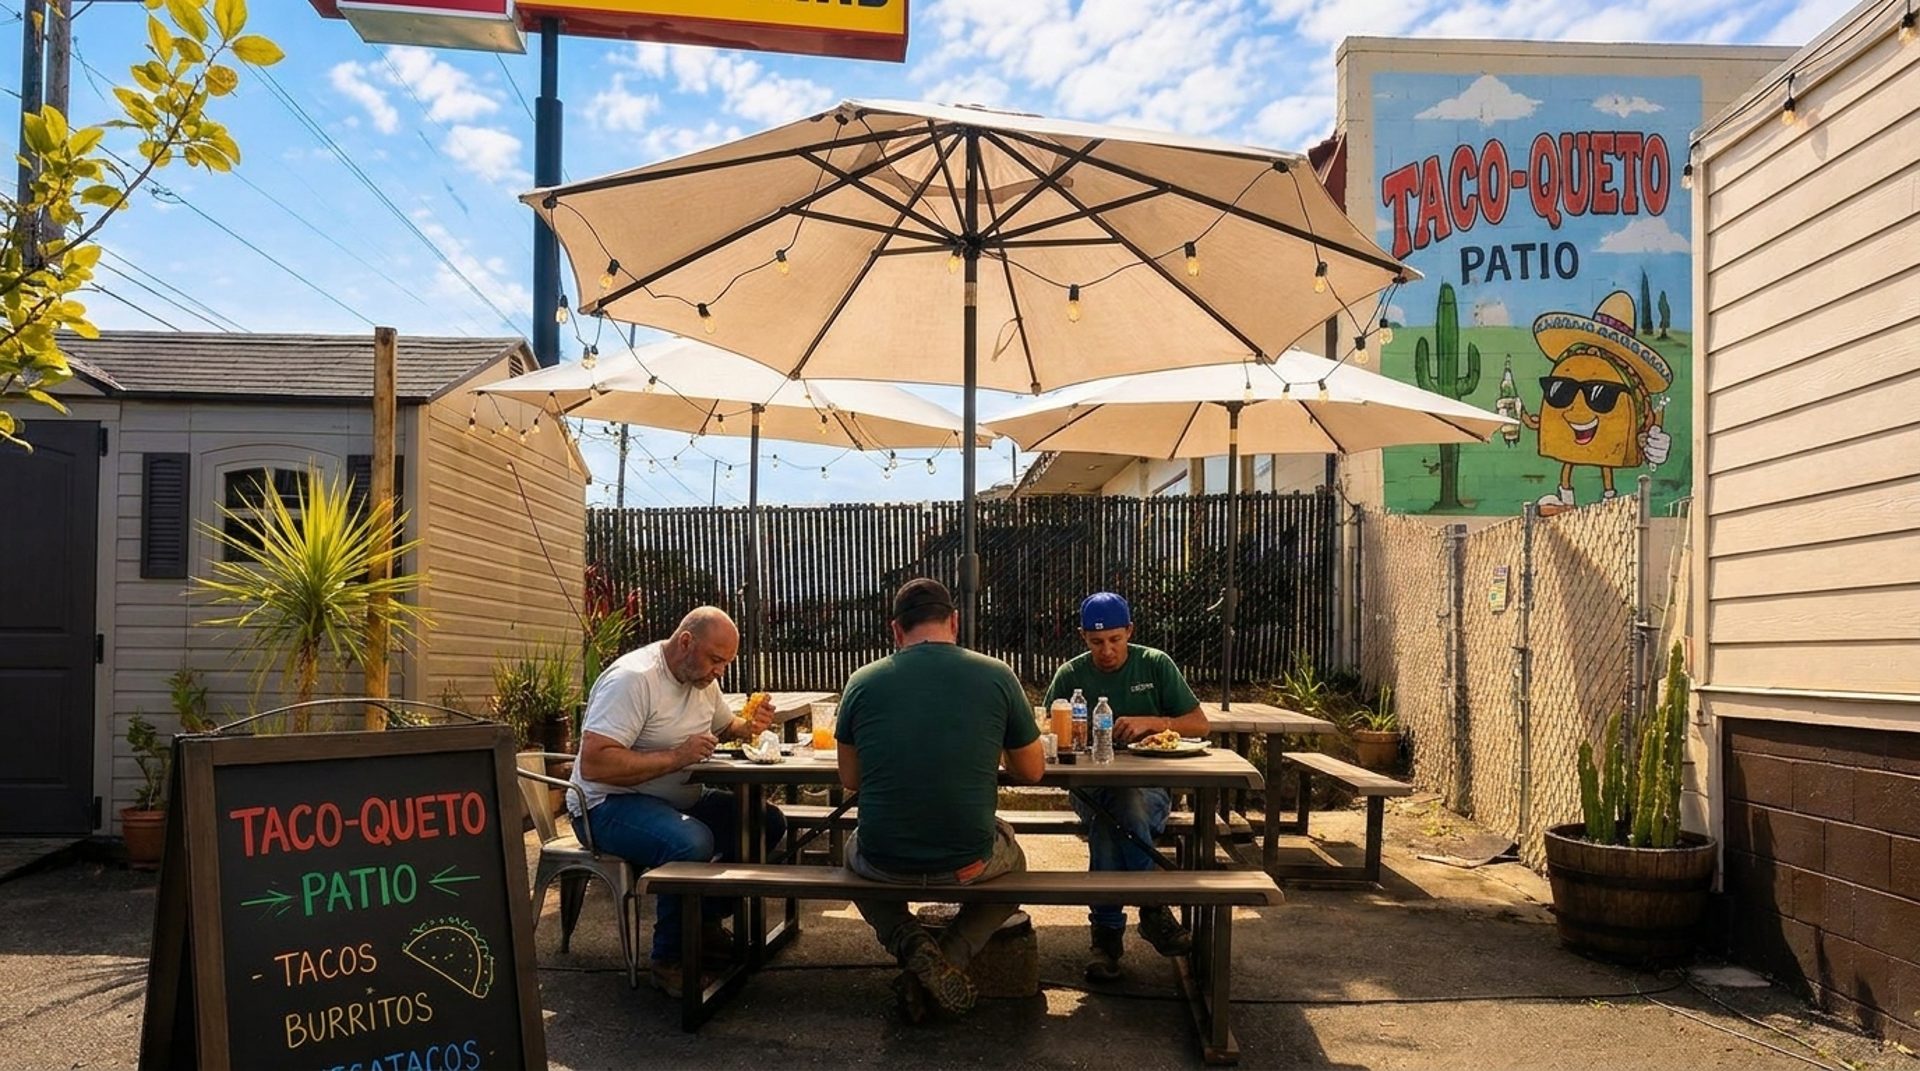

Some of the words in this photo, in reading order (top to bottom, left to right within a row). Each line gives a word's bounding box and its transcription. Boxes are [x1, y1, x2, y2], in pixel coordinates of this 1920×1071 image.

[1382, 131, 1670, 260] TACO-QUETO
[1460, 241, 1579, 286] PATIO
[230, 791, 487, 857] TACO-QUETO
[302, 864, 417, 916] PATIO
[274, 943, 378, 987] TACOS
[285, 992, 434, 1049] BURRITOS
